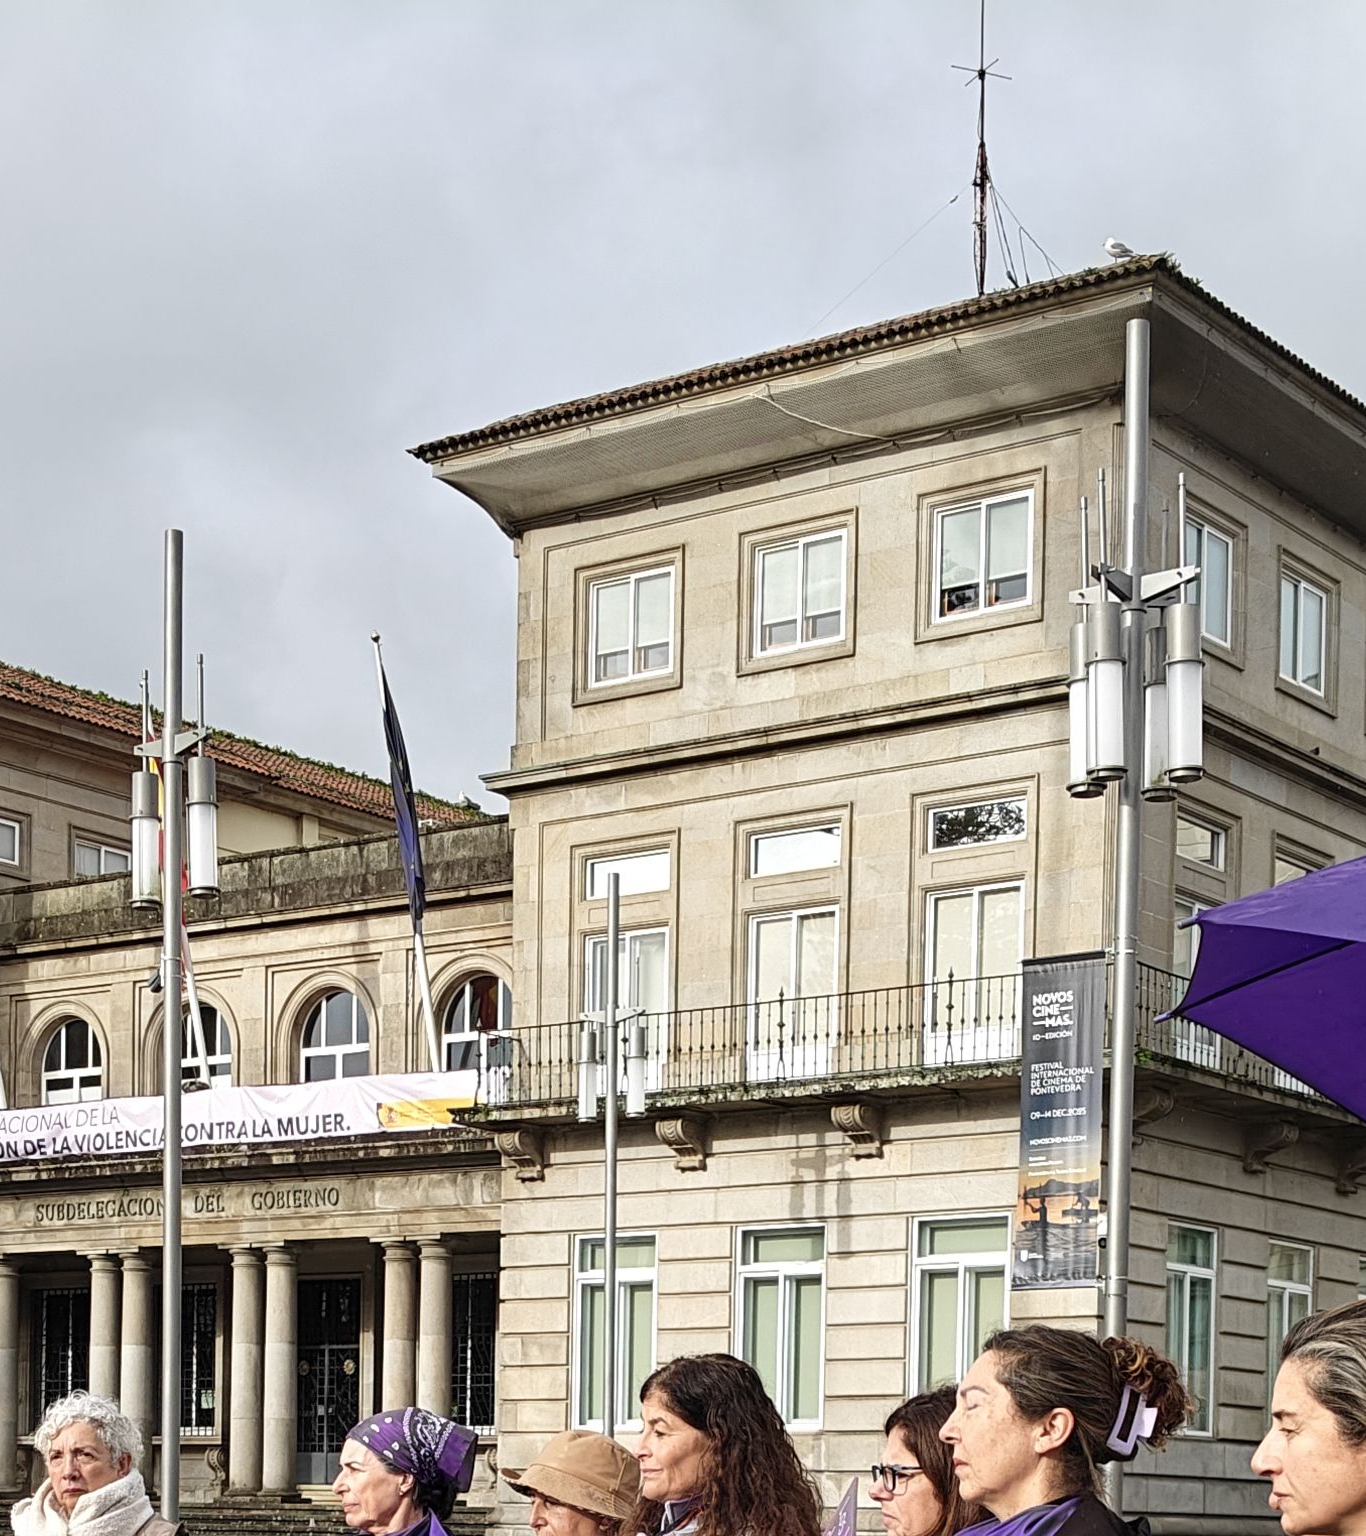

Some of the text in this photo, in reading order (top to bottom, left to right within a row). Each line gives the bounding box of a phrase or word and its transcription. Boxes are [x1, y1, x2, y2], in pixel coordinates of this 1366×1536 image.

[1032, 990, 1074, 1006] NOVOS
[1031, 1061, 1064, 1072] FESTIVAL
[1031, 1066, 1095, 1080] INTERNACIONAL
[1030, 1074, 1086, 1088] DE CINEMA DE
[1030, 1084, 1082, 1096] PONTEVEDRA
[77, 1108, 98, 1127] DE
[103, 1106, 120, 1124] LA
[23, 1137, 46, 1156] DE
[53, 1135, 71, 1154] LA
[181, 1119, 249, 1143] ONTRA
[252, 1118, 273, 1138] LA
[278, 1112, 351, 1135] MUJER.
[194, 1193, 225, 1214] DEL
[251, 1187, 340, 1210] GOBIERNO
